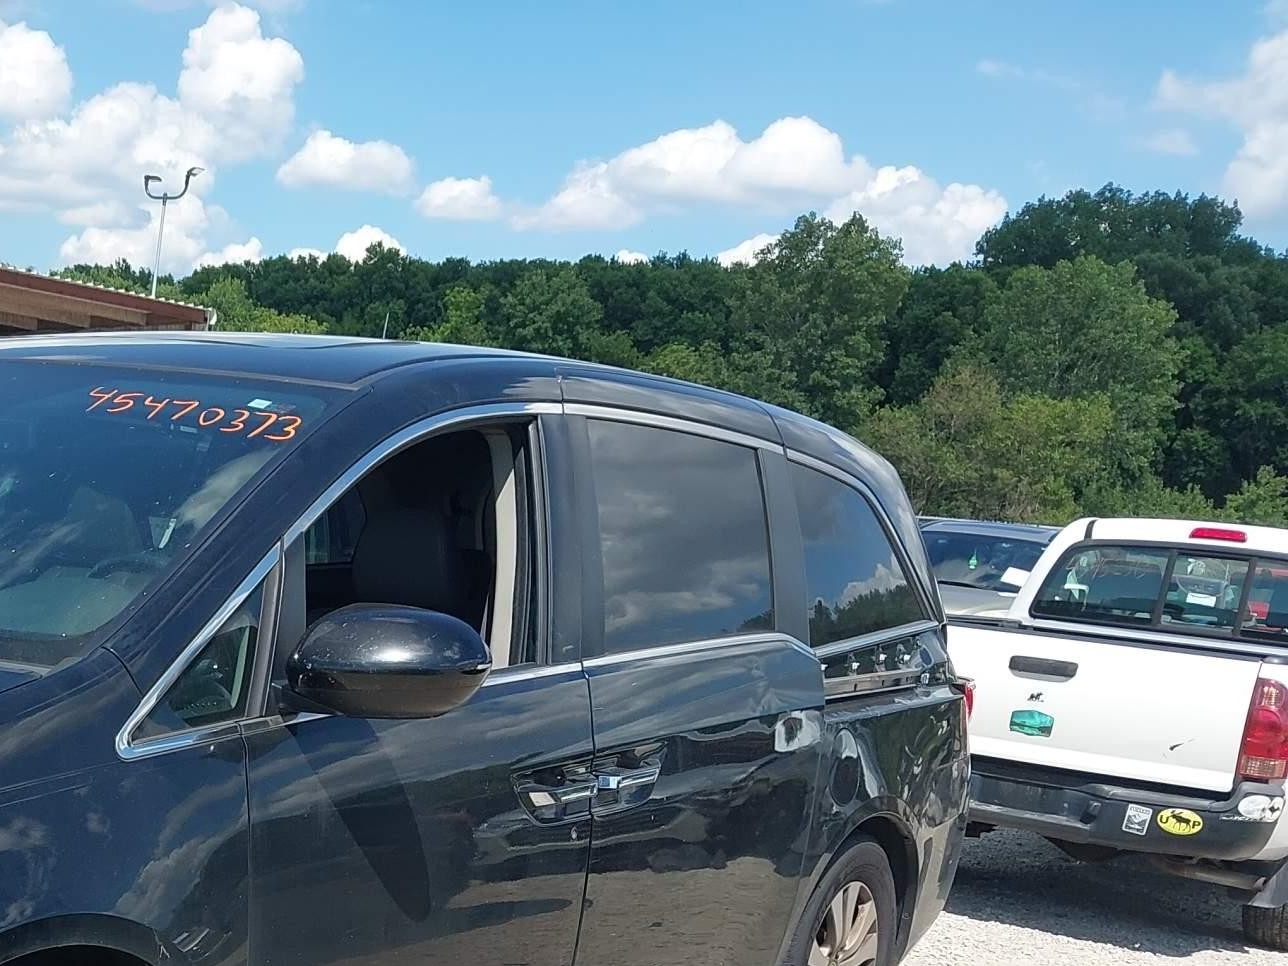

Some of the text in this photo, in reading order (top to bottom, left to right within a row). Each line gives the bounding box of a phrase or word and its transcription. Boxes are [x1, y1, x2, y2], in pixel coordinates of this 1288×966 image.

[85, 386, 302, 441] 45470373
[1159, 815, 1201, 830] U P
